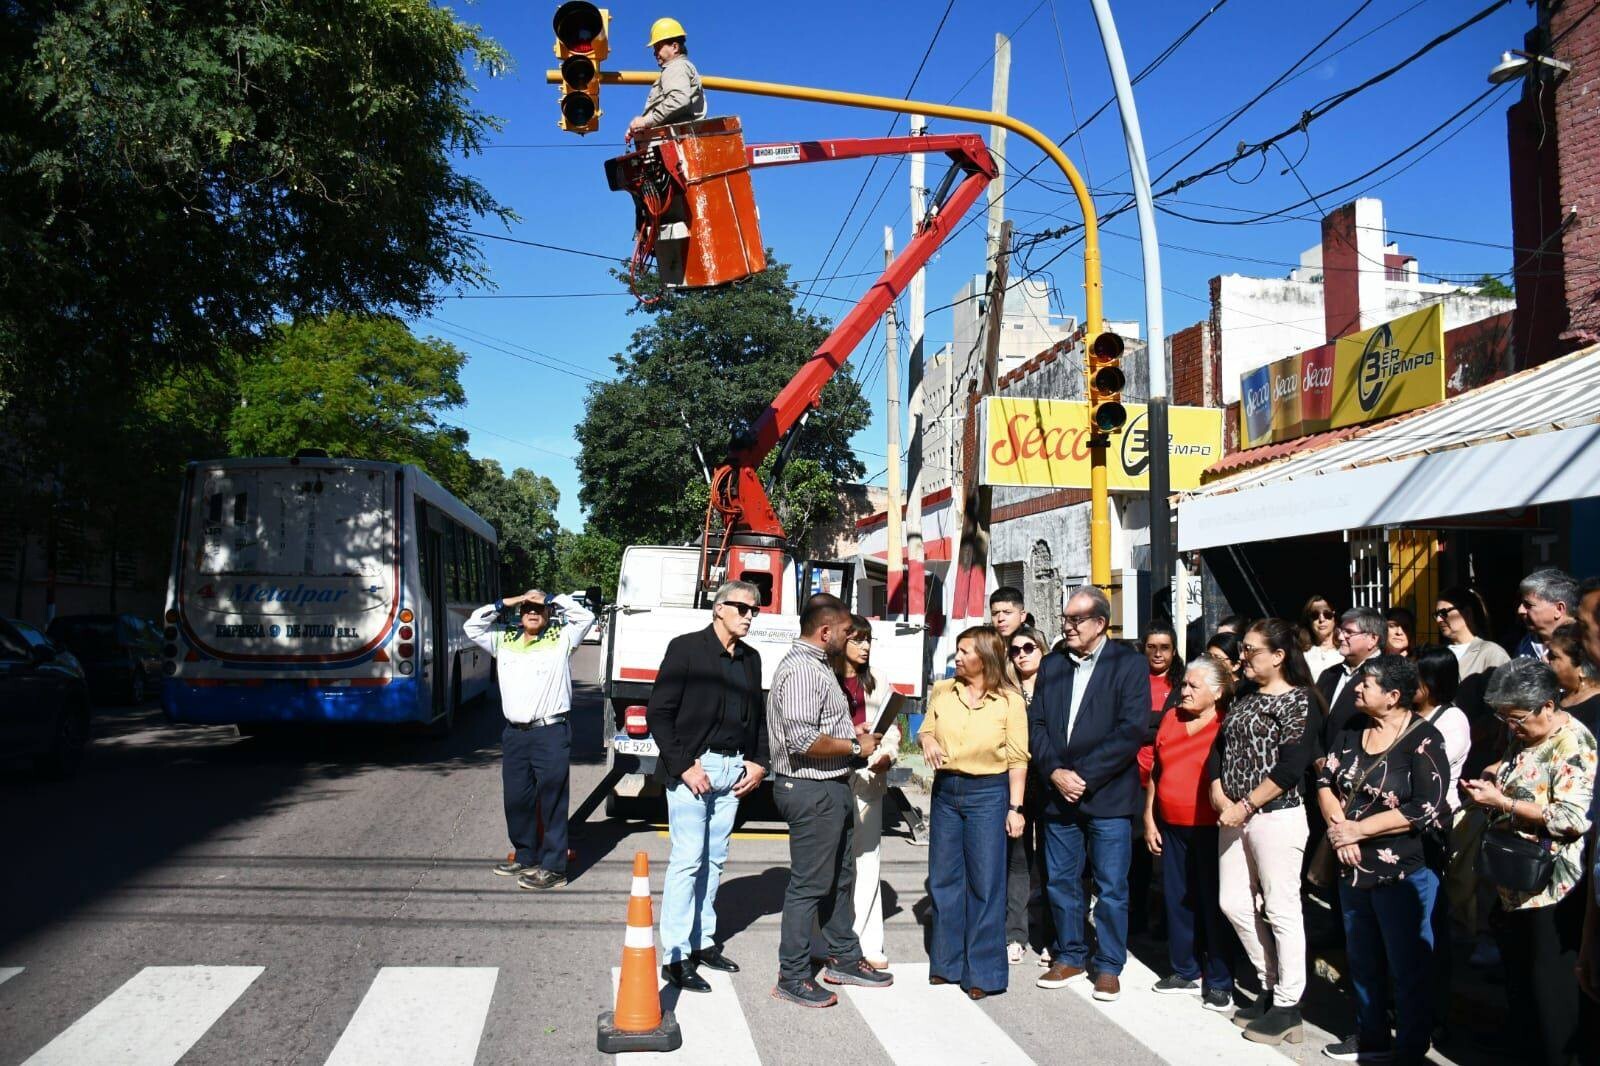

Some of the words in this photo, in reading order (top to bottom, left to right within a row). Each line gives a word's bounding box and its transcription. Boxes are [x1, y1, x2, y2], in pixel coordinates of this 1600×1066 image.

[1303, 362, 1332, 392] Secco
[1366, 351, 1381, 382] 3
[1382, 349, 1399, 365] ER
[1381, 352, 1434, 378] TIEMPO
[1246, 382, 1270, 416] Secco
[1273, 374, 1298, 402] Secco
[991, 414, 1092, 466] Secco
[1131, 429, 1149, 452] 3
[1167, 444, 1211, 456] EMPO
[229, 583, 349, 606] Metalpar
[215, 624, 265, 638] EMPRESA
[286, 624, 301, 637] DE
[303, 624, 336, 637] JULIO
[633, 741, 653, 753] 529
